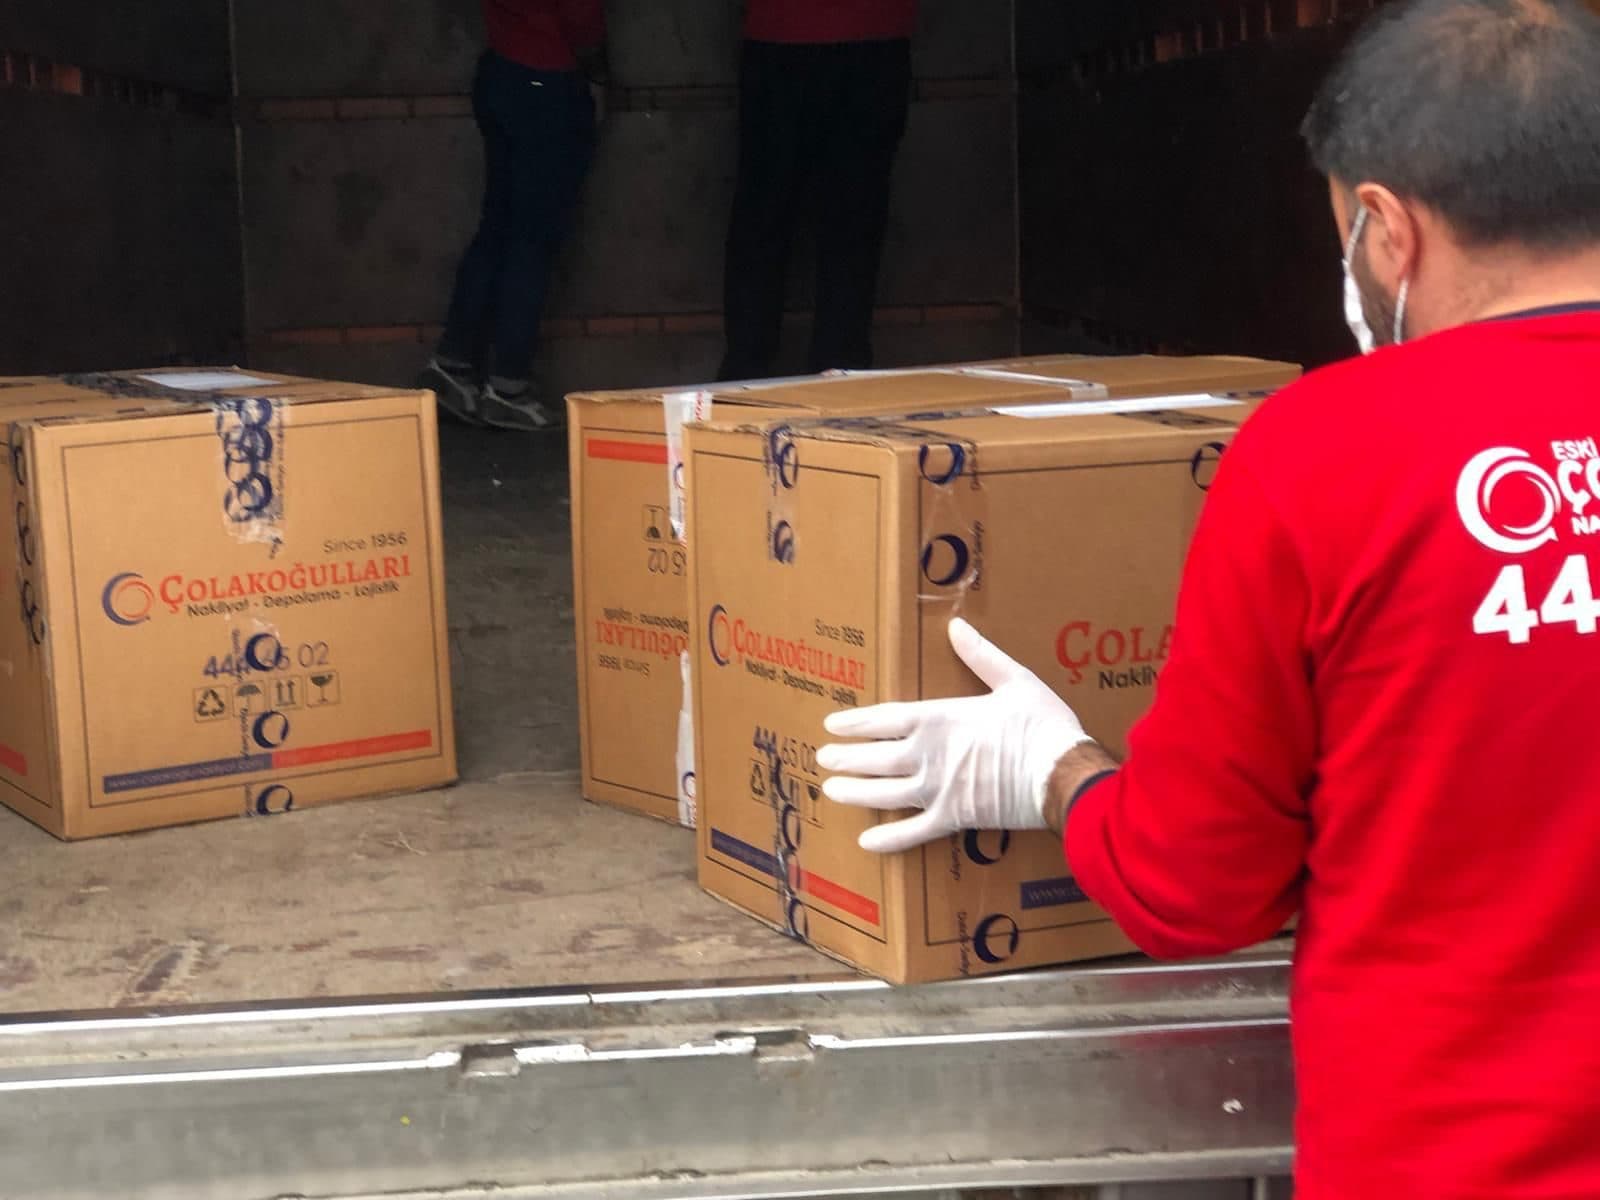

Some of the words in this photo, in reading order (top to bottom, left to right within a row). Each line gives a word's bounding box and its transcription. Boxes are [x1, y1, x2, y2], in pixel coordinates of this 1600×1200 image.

[323, 538, 367, 554] Since
[371, 531, 408, 548] 1956
[159, 554, 411, 615] ÇOLAKOĞULLARI
[263, 588, 341, 609] Depolama
[1473, 554, 1600, 644] 44
[297, 639, 330, 668] 02
[594, 619, 688, 660] OĞULLARI
[733, 618, 865, 690] ÇOLAKOĞULLARI
